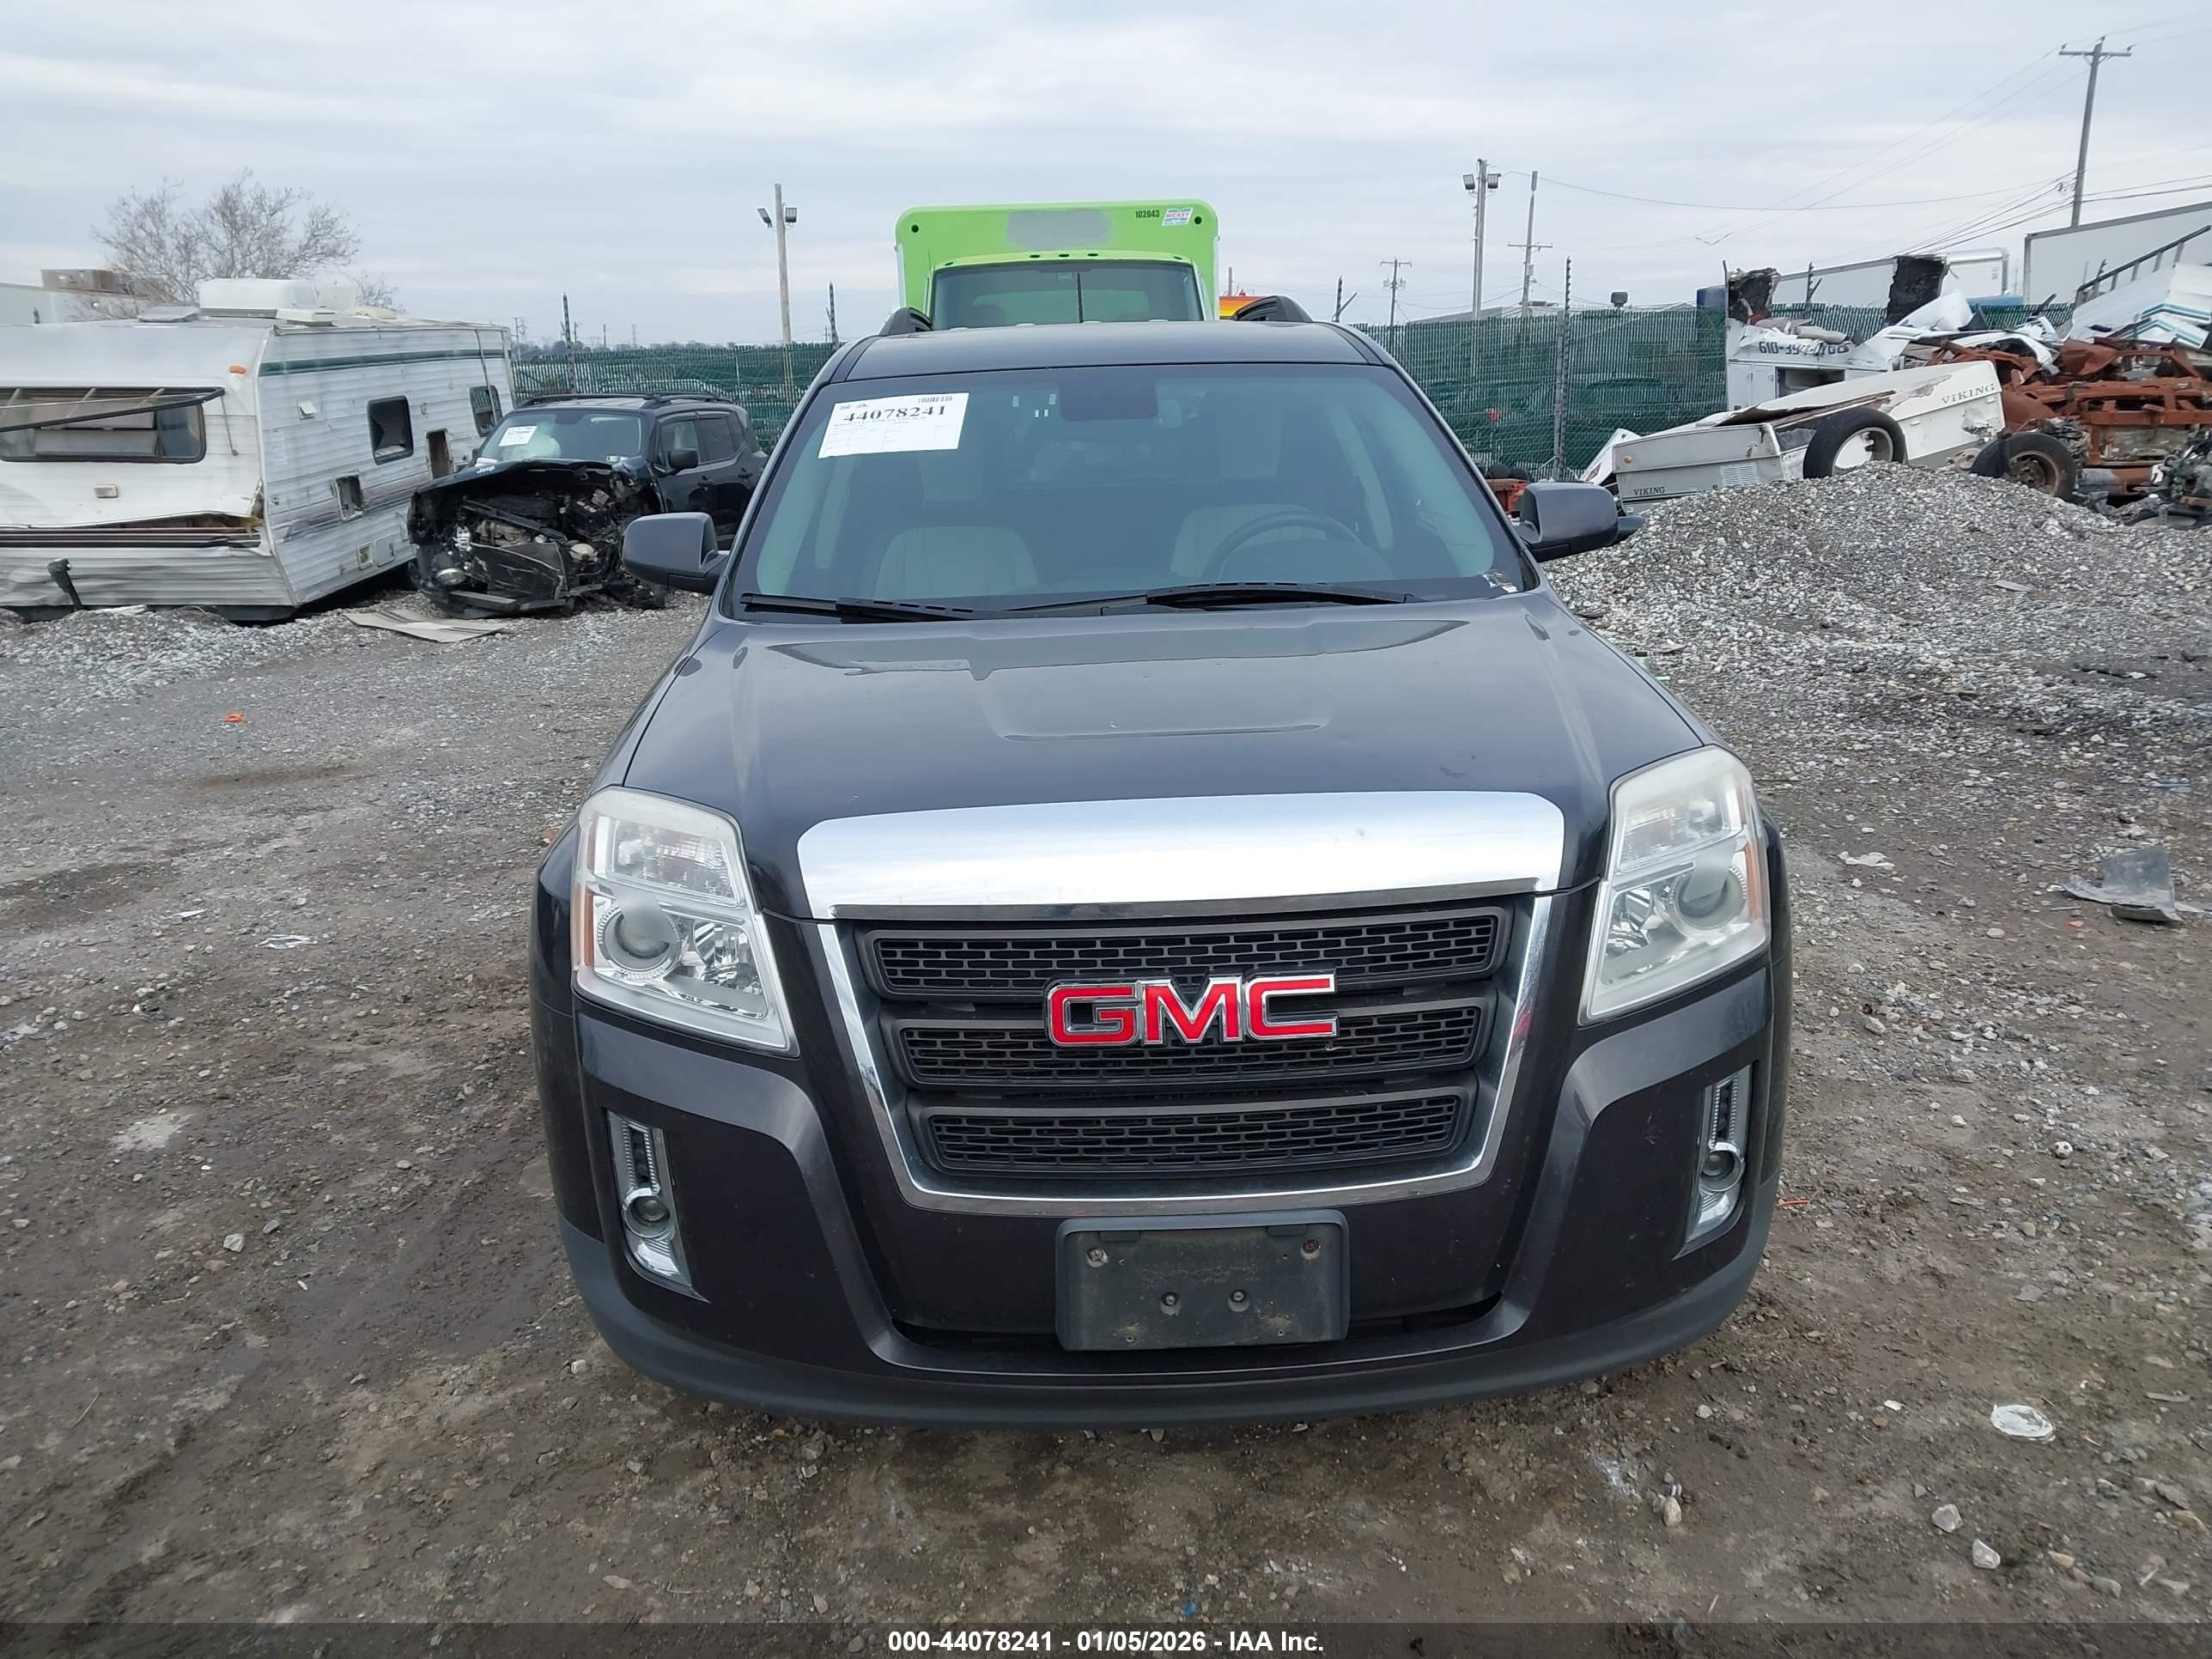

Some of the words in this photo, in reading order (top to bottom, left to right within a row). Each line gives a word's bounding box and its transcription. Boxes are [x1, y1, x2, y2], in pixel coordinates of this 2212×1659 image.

[843, 404, 945, 422] 44078241
[1633, 486, 1665, 495] VIKING
[1047, 972, 1337, 1047] GMC
